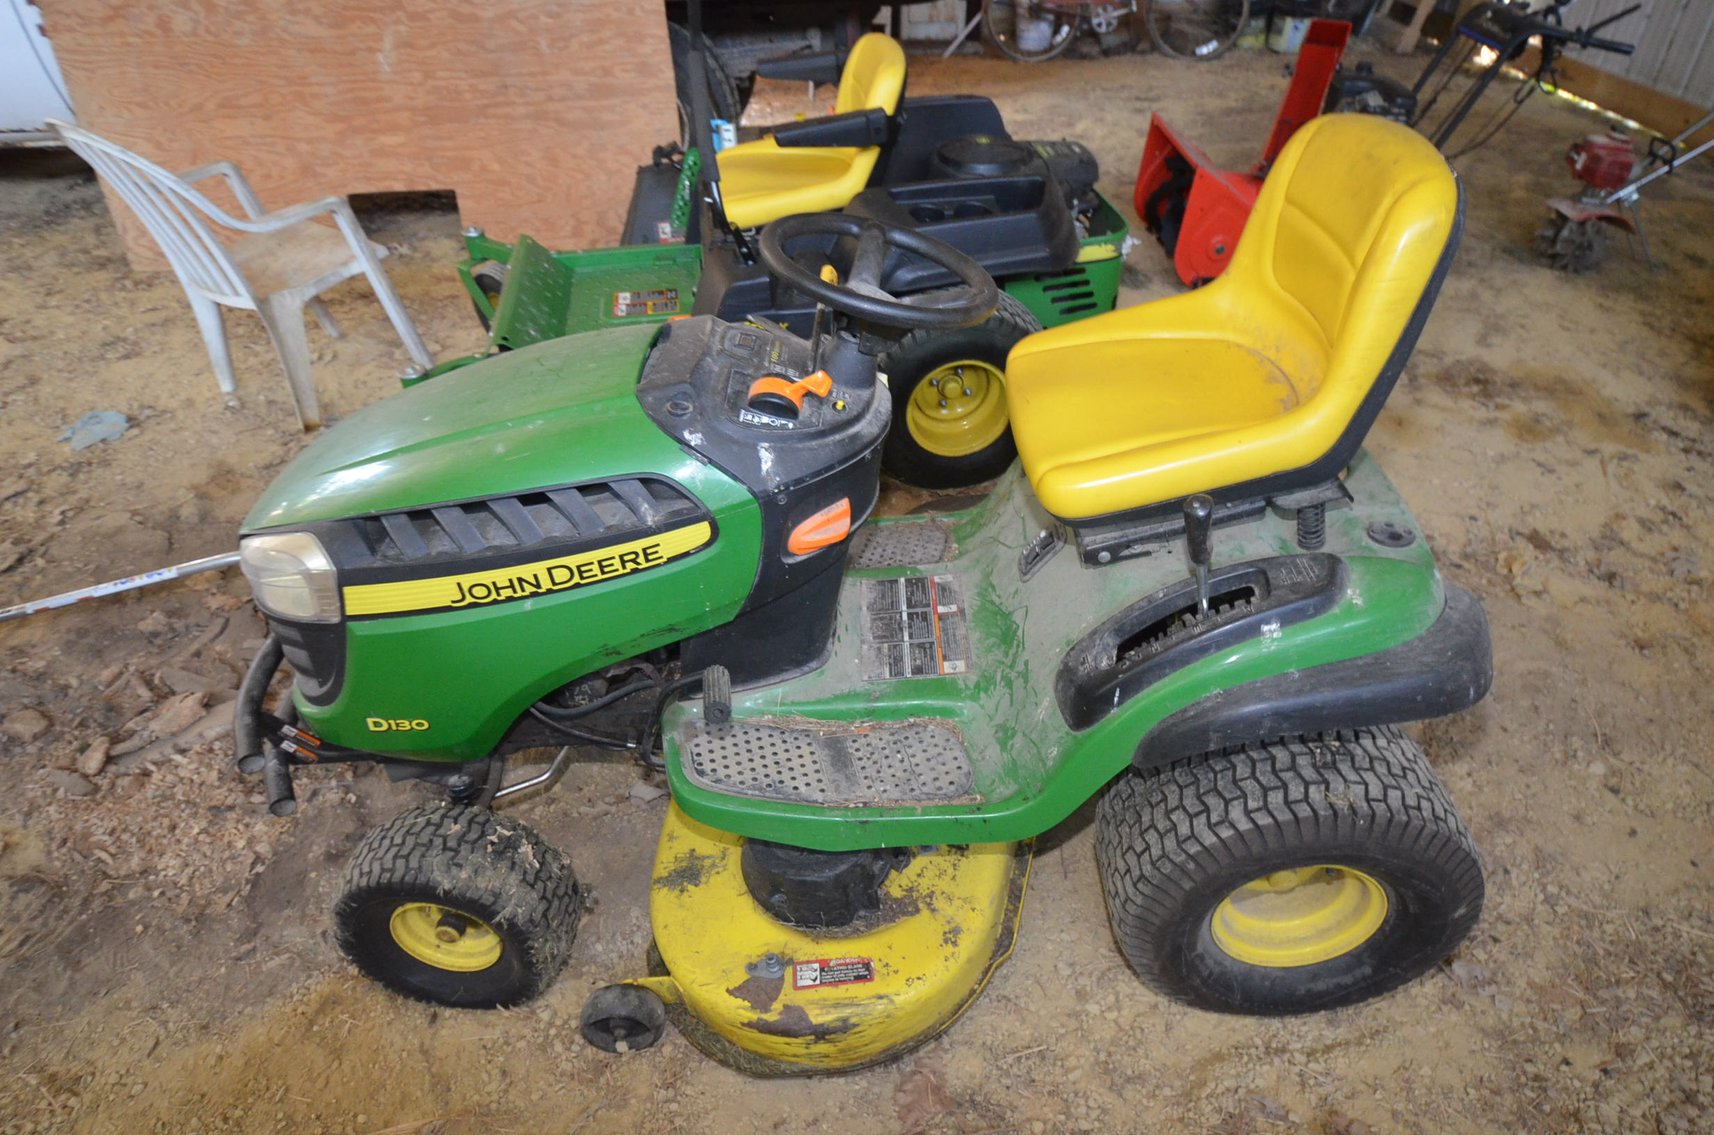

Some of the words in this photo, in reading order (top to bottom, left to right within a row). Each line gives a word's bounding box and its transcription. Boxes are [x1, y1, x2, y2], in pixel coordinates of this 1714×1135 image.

[451, 573, 543, 604] JOHN
[546, 543, 664, 588] DEERE
[366, 717, 430, 732] D130
